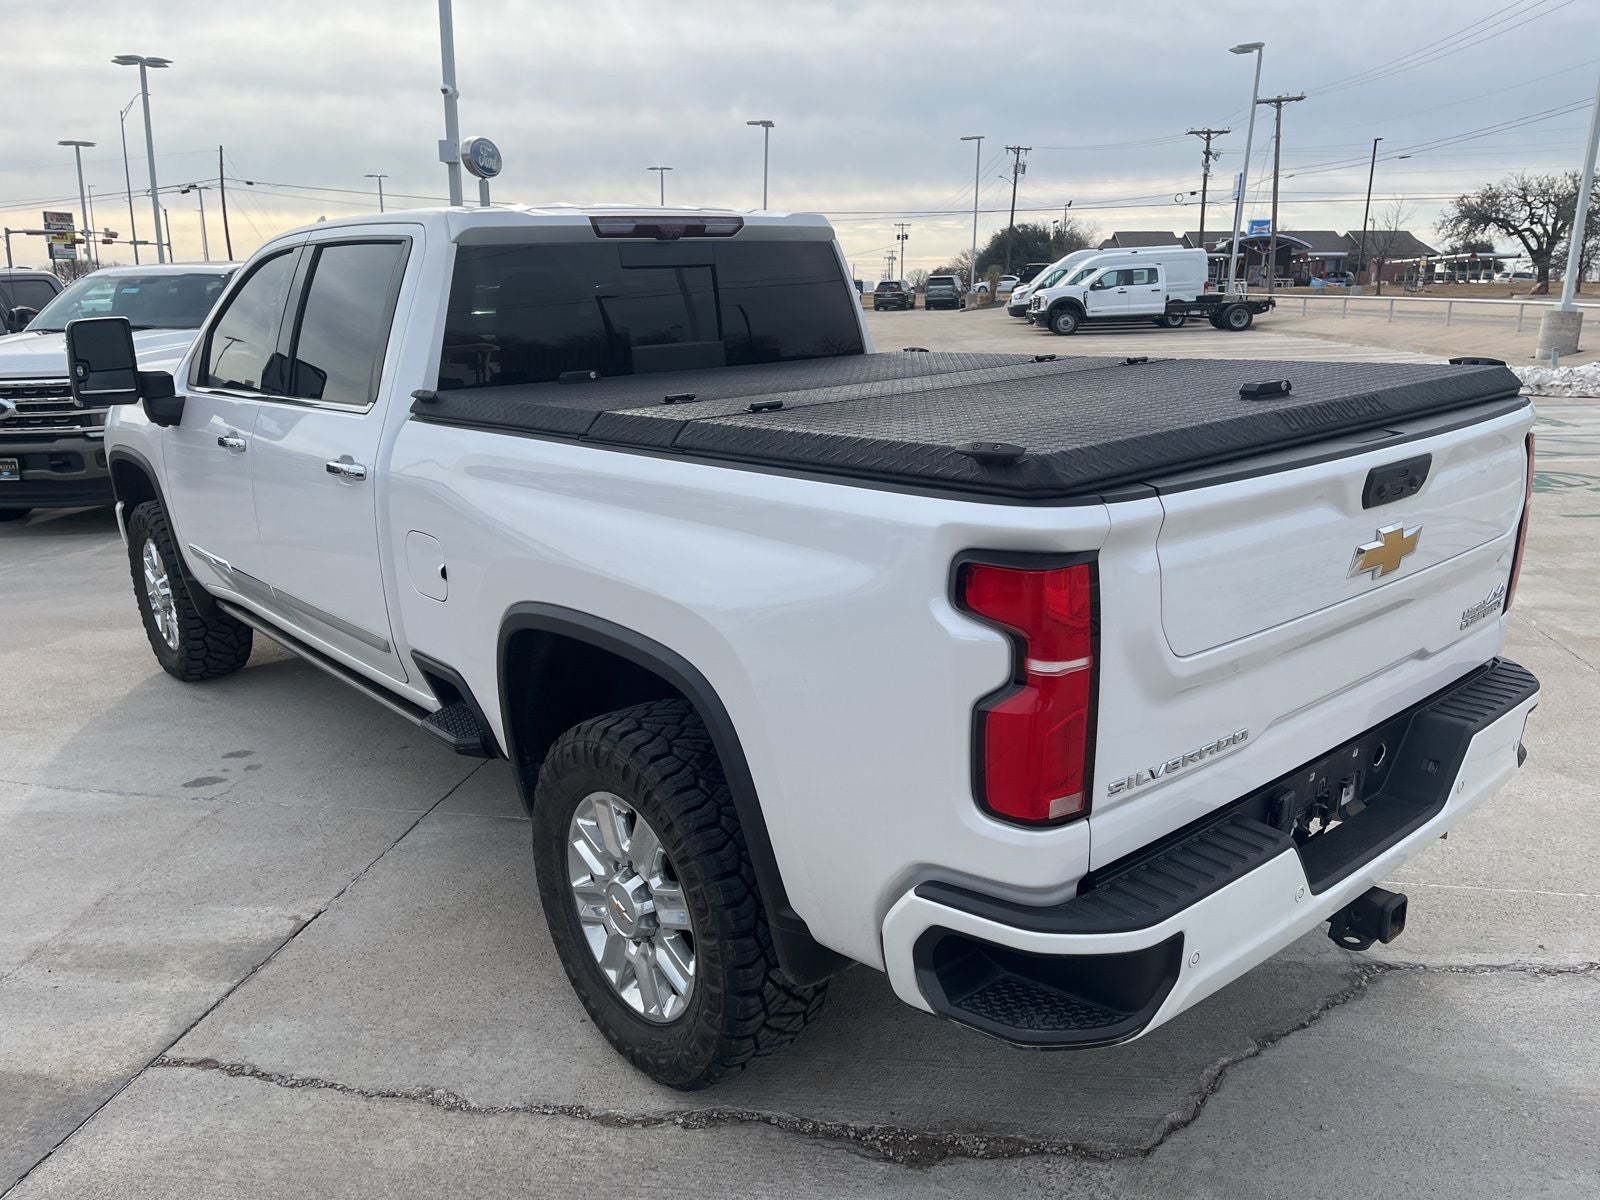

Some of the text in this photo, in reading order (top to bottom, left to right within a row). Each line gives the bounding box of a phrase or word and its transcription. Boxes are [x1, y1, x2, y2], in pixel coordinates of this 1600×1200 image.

[478, 144, 498, 168] Ford
[1278, 393, 1392, 432] DIAMONDBACK
[1107, 727, 1249, 797] SILVERADO
